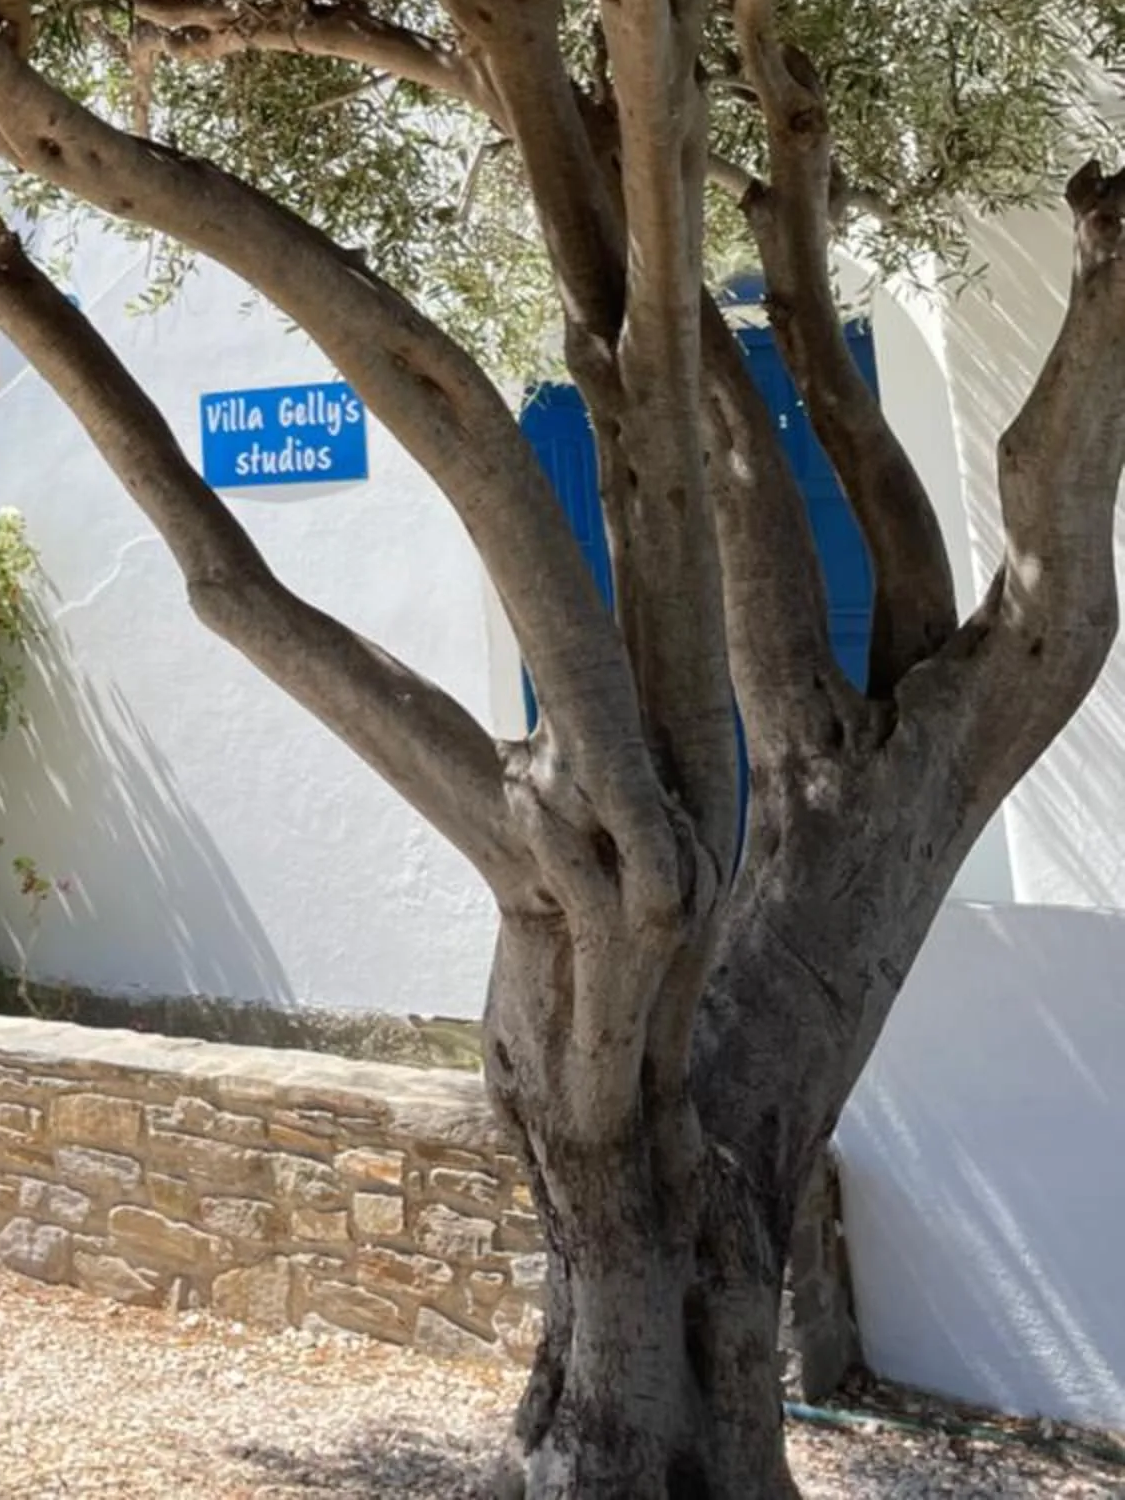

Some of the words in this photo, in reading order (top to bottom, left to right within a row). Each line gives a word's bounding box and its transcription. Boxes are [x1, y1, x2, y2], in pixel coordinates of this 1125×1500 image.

[206, 398, 264, 433] Villa
[278, 391, 361, 436] Gelly's
[235, 436, 332, 475] studios
